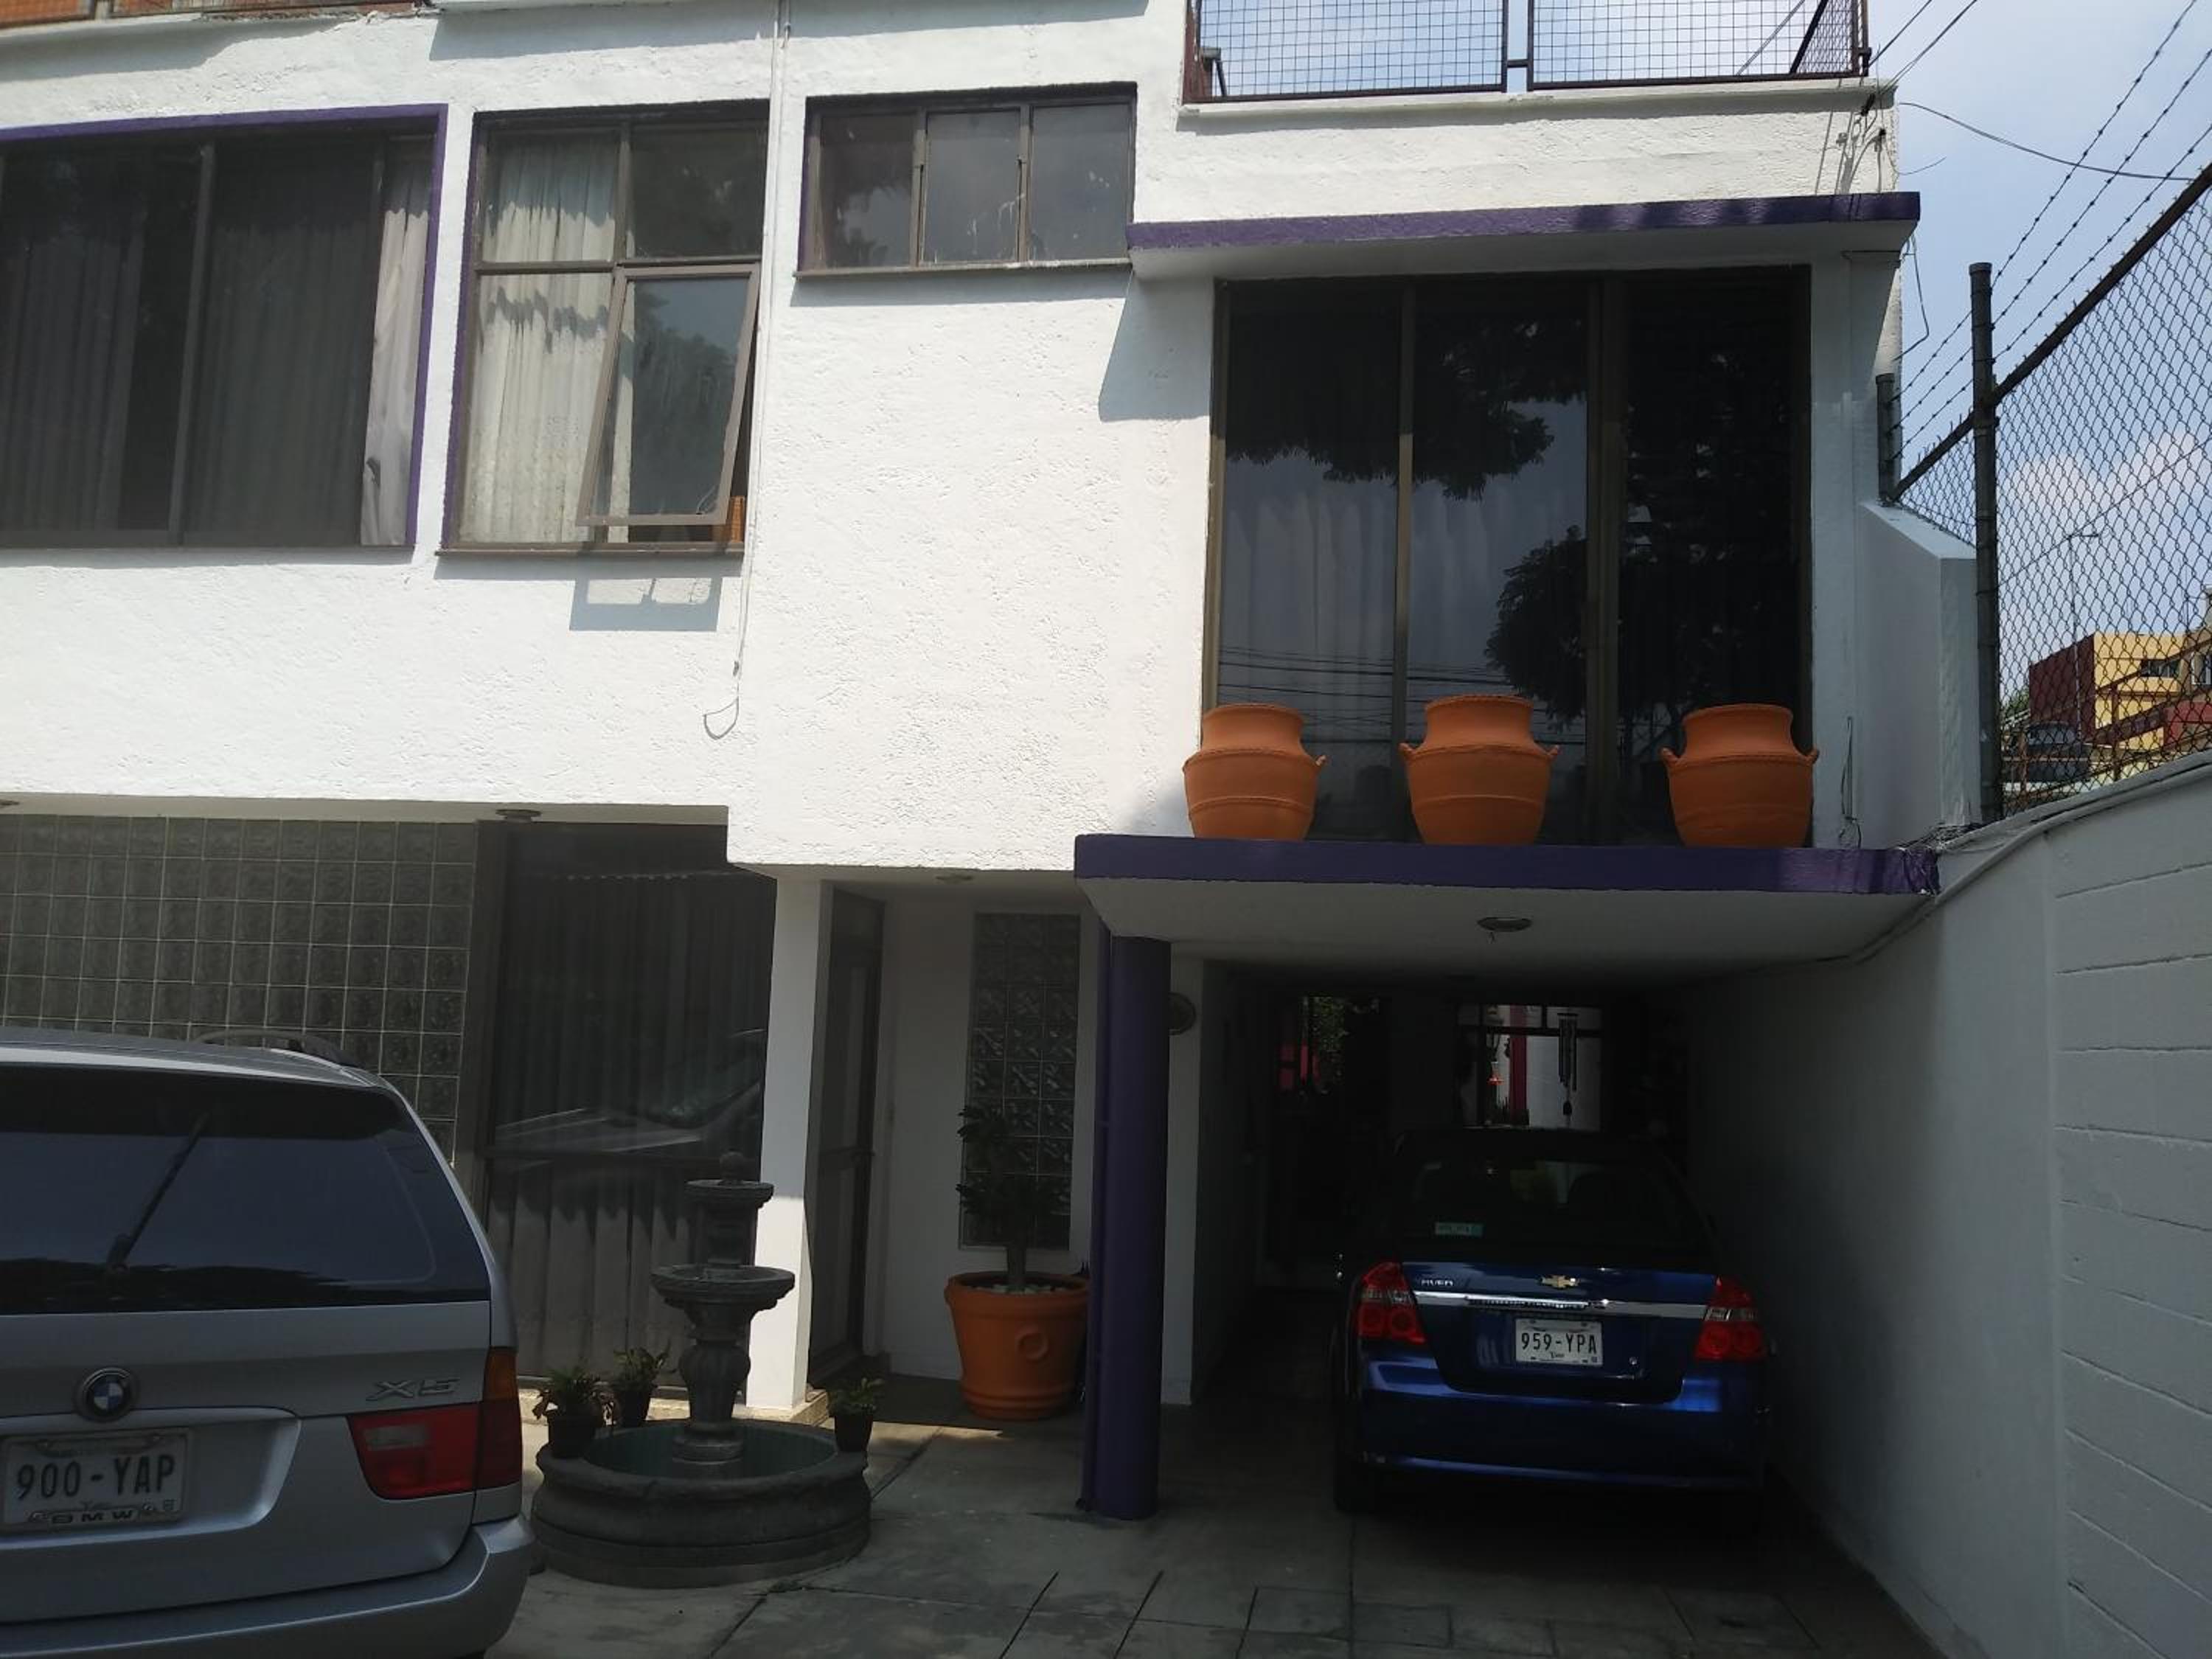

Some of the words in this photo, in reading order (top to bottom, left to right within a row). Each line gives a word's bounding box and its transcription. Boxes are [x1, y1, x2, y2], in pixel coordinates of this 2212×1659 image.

[1520, 1332, 1597, 1354] 959-YPA
[366, 1380, 460, 1401] X5
[15, 1454, 176, 1500] 900-YAP
